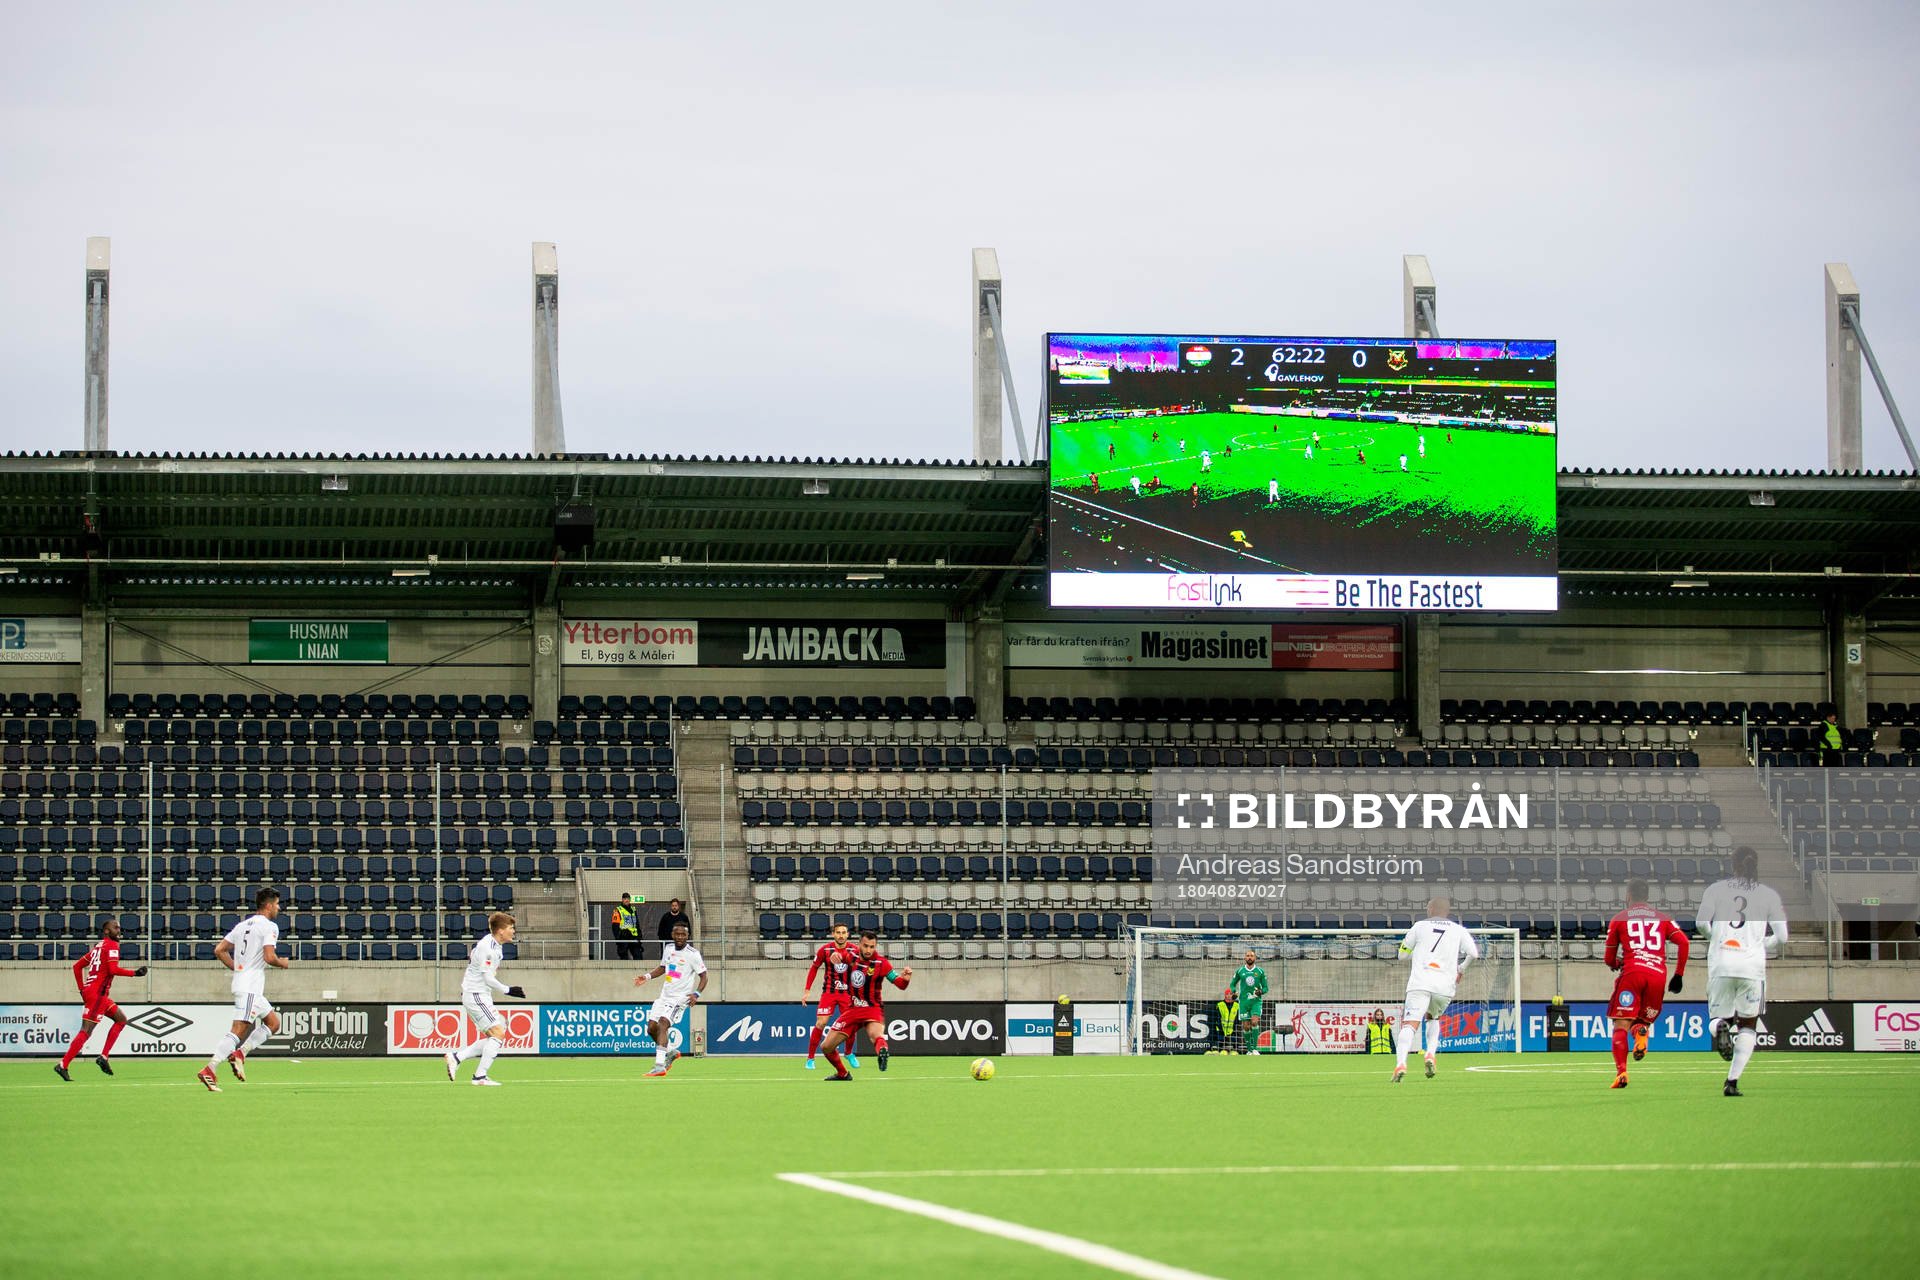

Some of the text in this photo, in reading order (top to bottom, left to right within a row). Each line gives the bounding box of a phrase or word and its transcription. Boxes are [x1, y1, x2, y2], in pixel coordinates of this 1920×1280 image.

[1231, 347, 1367, 368] 2 62:22 0
[1336, 578, 1483, 608] Be The Fastest
[289, 624, 348, 640] HUSMAN
[563, 622, 693, 645] Ytterbom
[742, 627, 880, 661] JAMBACK
[1007, 636, 1130, 648] Var får du kraften ifrån?
[1141, 630, 1268, 662] Magasinet
[299, 643, 339, 659] I NIAN
[581, 649, 675, 663] El, Bygg & Måleri
[882, 651, 905, 660] MEDIA
[1849, 648, 1859, 661] S
[1729, 896, 1747, 929] 3
[241, 930, 251, 956] 5
[1430, 928, 1446, 953] 7
[1627, 919, 1662, 951] 93
[32, 1013, 48, 1024] för
[262, 1006, 368, 1039] gström
[546, 1009, 620, 1023] VARNING
[1315, 1010, 1396, 1027] Gästrie
[884, 1019, 993, 1041] enovo
[1025, 1022, 1078, 1034] Dane
[1086, 1022, 1121, 1034] Bank
[1319, 1027, 1357, 1042] Plåt
[1664, 1011, 1704, 1042] 1/8
[24, 1028, 70, 1044] Gävle
[1454, 1036, 1482, 1047] MUSIK
[1789, 1031, 1844, 1046] adidas
[131, 1040, 187, 1053] umbro
[1158, 1041, 1184, 1050] drilling
[1904, 1039, 1917, 1050] Be
